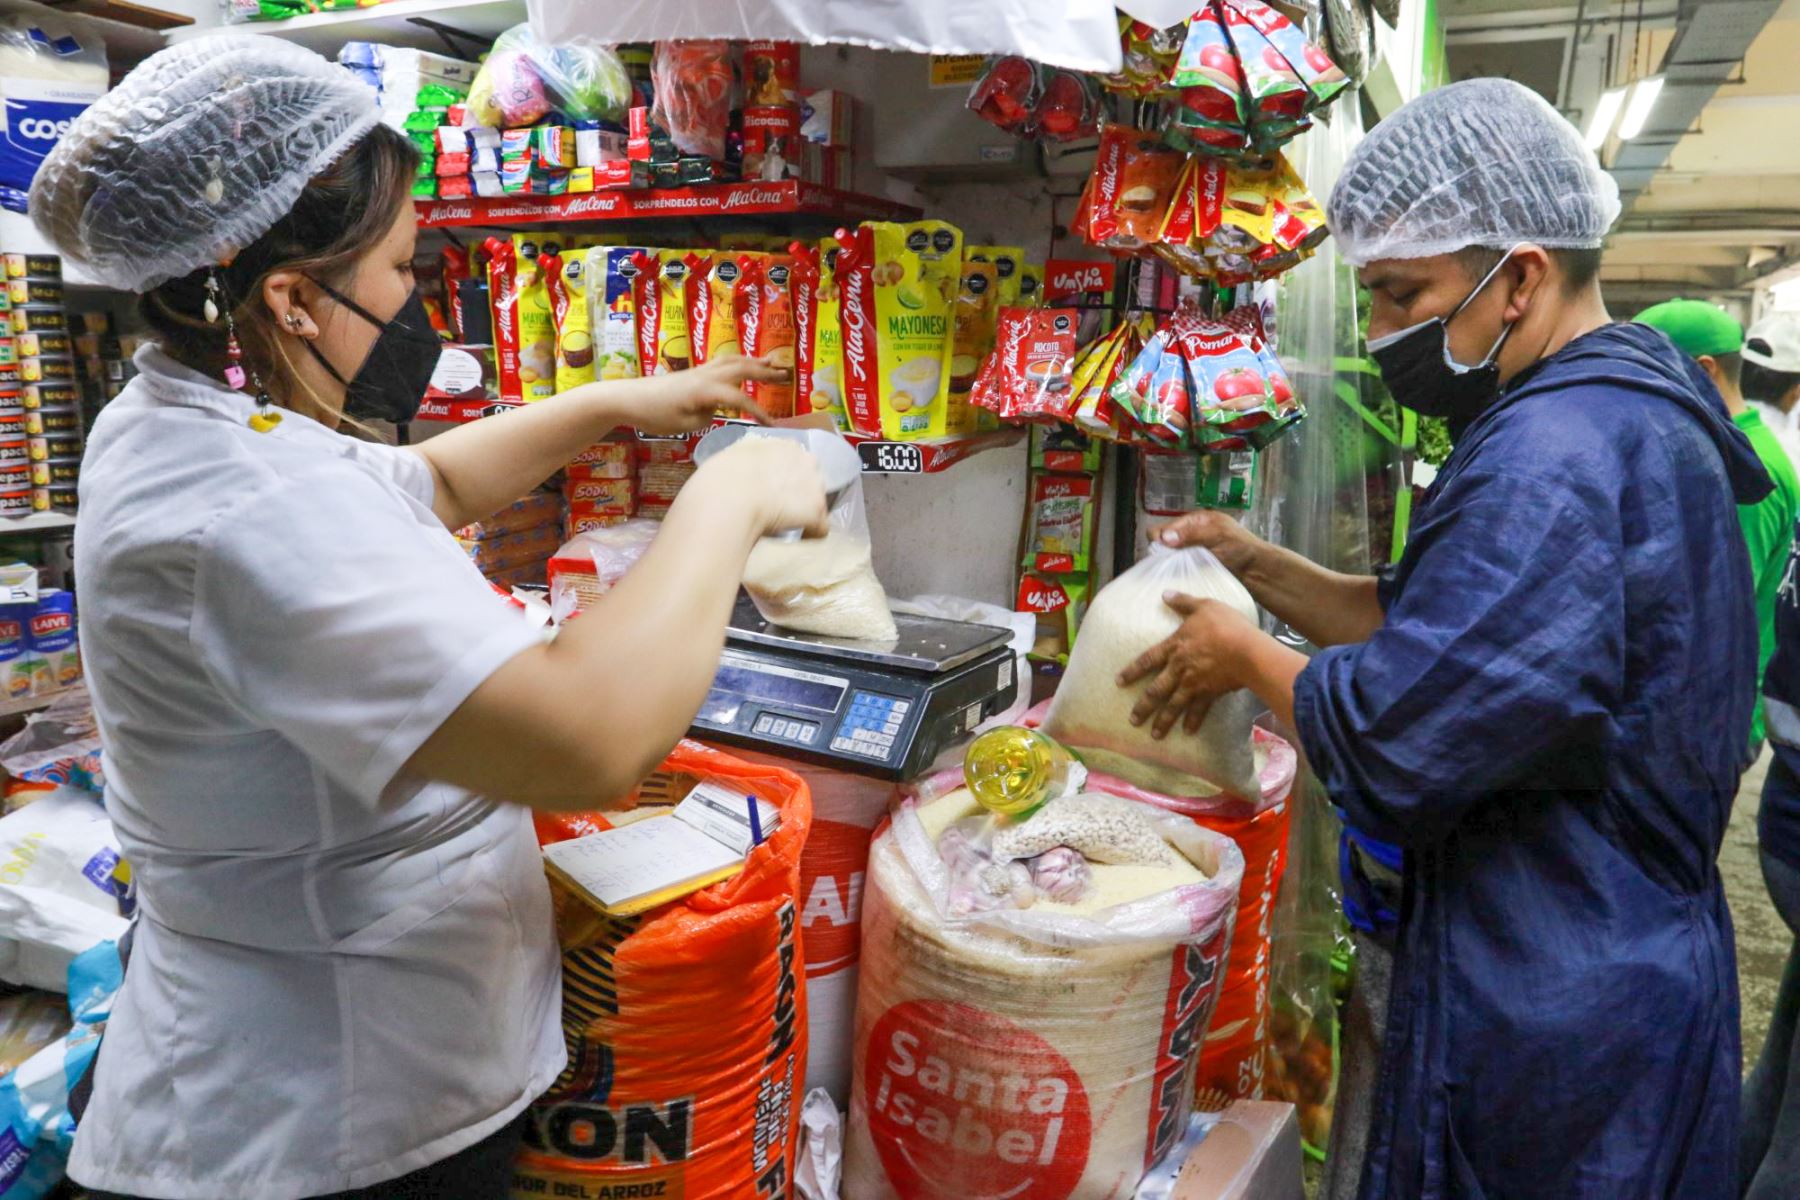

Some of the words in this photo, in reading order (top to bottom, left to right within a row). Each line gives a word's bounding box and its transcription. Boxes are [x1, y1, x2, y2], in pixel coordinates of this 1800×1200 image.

[19, 117, 76, 139] cos
[1102, 143, 1118, 201] AlaCena
[562, 197, 615, 216] AlaCena
[701, 197, 719, 207] CON
[721, 189, 782, 209] AlaCena
[426, 205, 472, 223] AlaCena
[641, 279, 657, 357] AlaCena
[693, 280, 707, 361] AlaCena
[797, 283, 810, 362] AlaCena
[842, 270, 867, 382] AlaCena
[889, 315, 947, 340] MAYONESA
[877, 445, 918, 470] 16.00
[576, 485, 608, 497] SODA
[578, 520, 606, 532] SODA
[33, 616, 68, 631] LAIVE
[886, 1030, 1068, 1114] Santa
[553, 1181, 591, 1199] DEL
[598, 1180, 667, 1200] ARROZ
